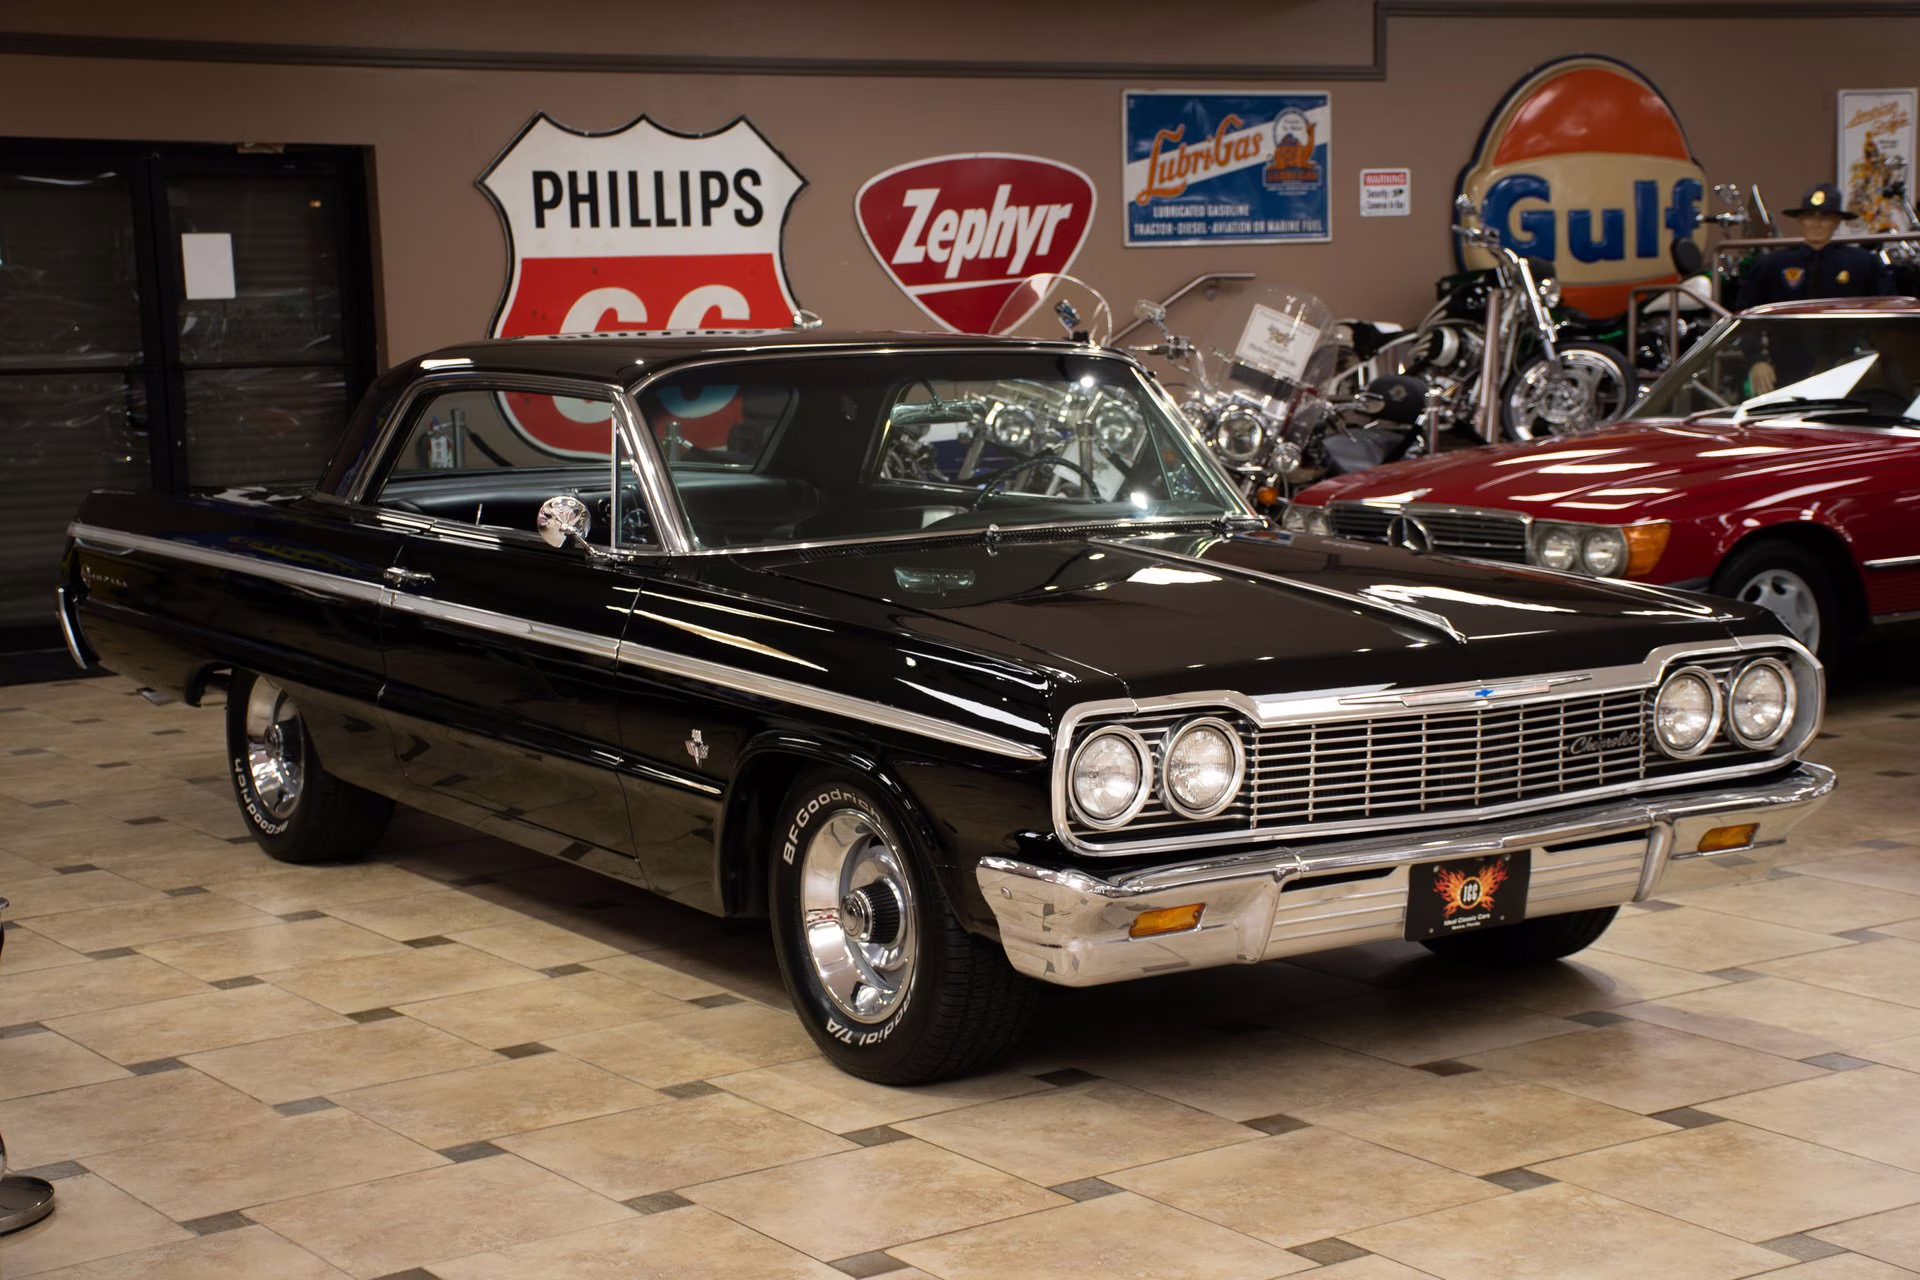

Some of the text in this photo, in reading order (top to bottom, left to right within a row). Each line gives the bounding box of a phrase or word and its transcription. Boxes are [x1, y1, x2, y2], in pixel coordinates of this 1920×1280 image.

[1365, 174, 1407, 185] WARNING
[532, 168, 763, 228] PHILLIPS
[1153, 204, 1249, 218] LUBRICATED GASOLINE
[891, 184, 1073, 279] Zephyr
[1252, 221, 1265, 233] OR
[1267, 220, 1300, 233] MARINE
[1302, 219, 1322, 232] FUEL
[1482, 173, 1703, 264] Gulf
[1569, 730, 1640, 755] Chevrolet
[783, 788, 881, 865] BFGoodrich
[825, 1017, 853, 1044] T/A
